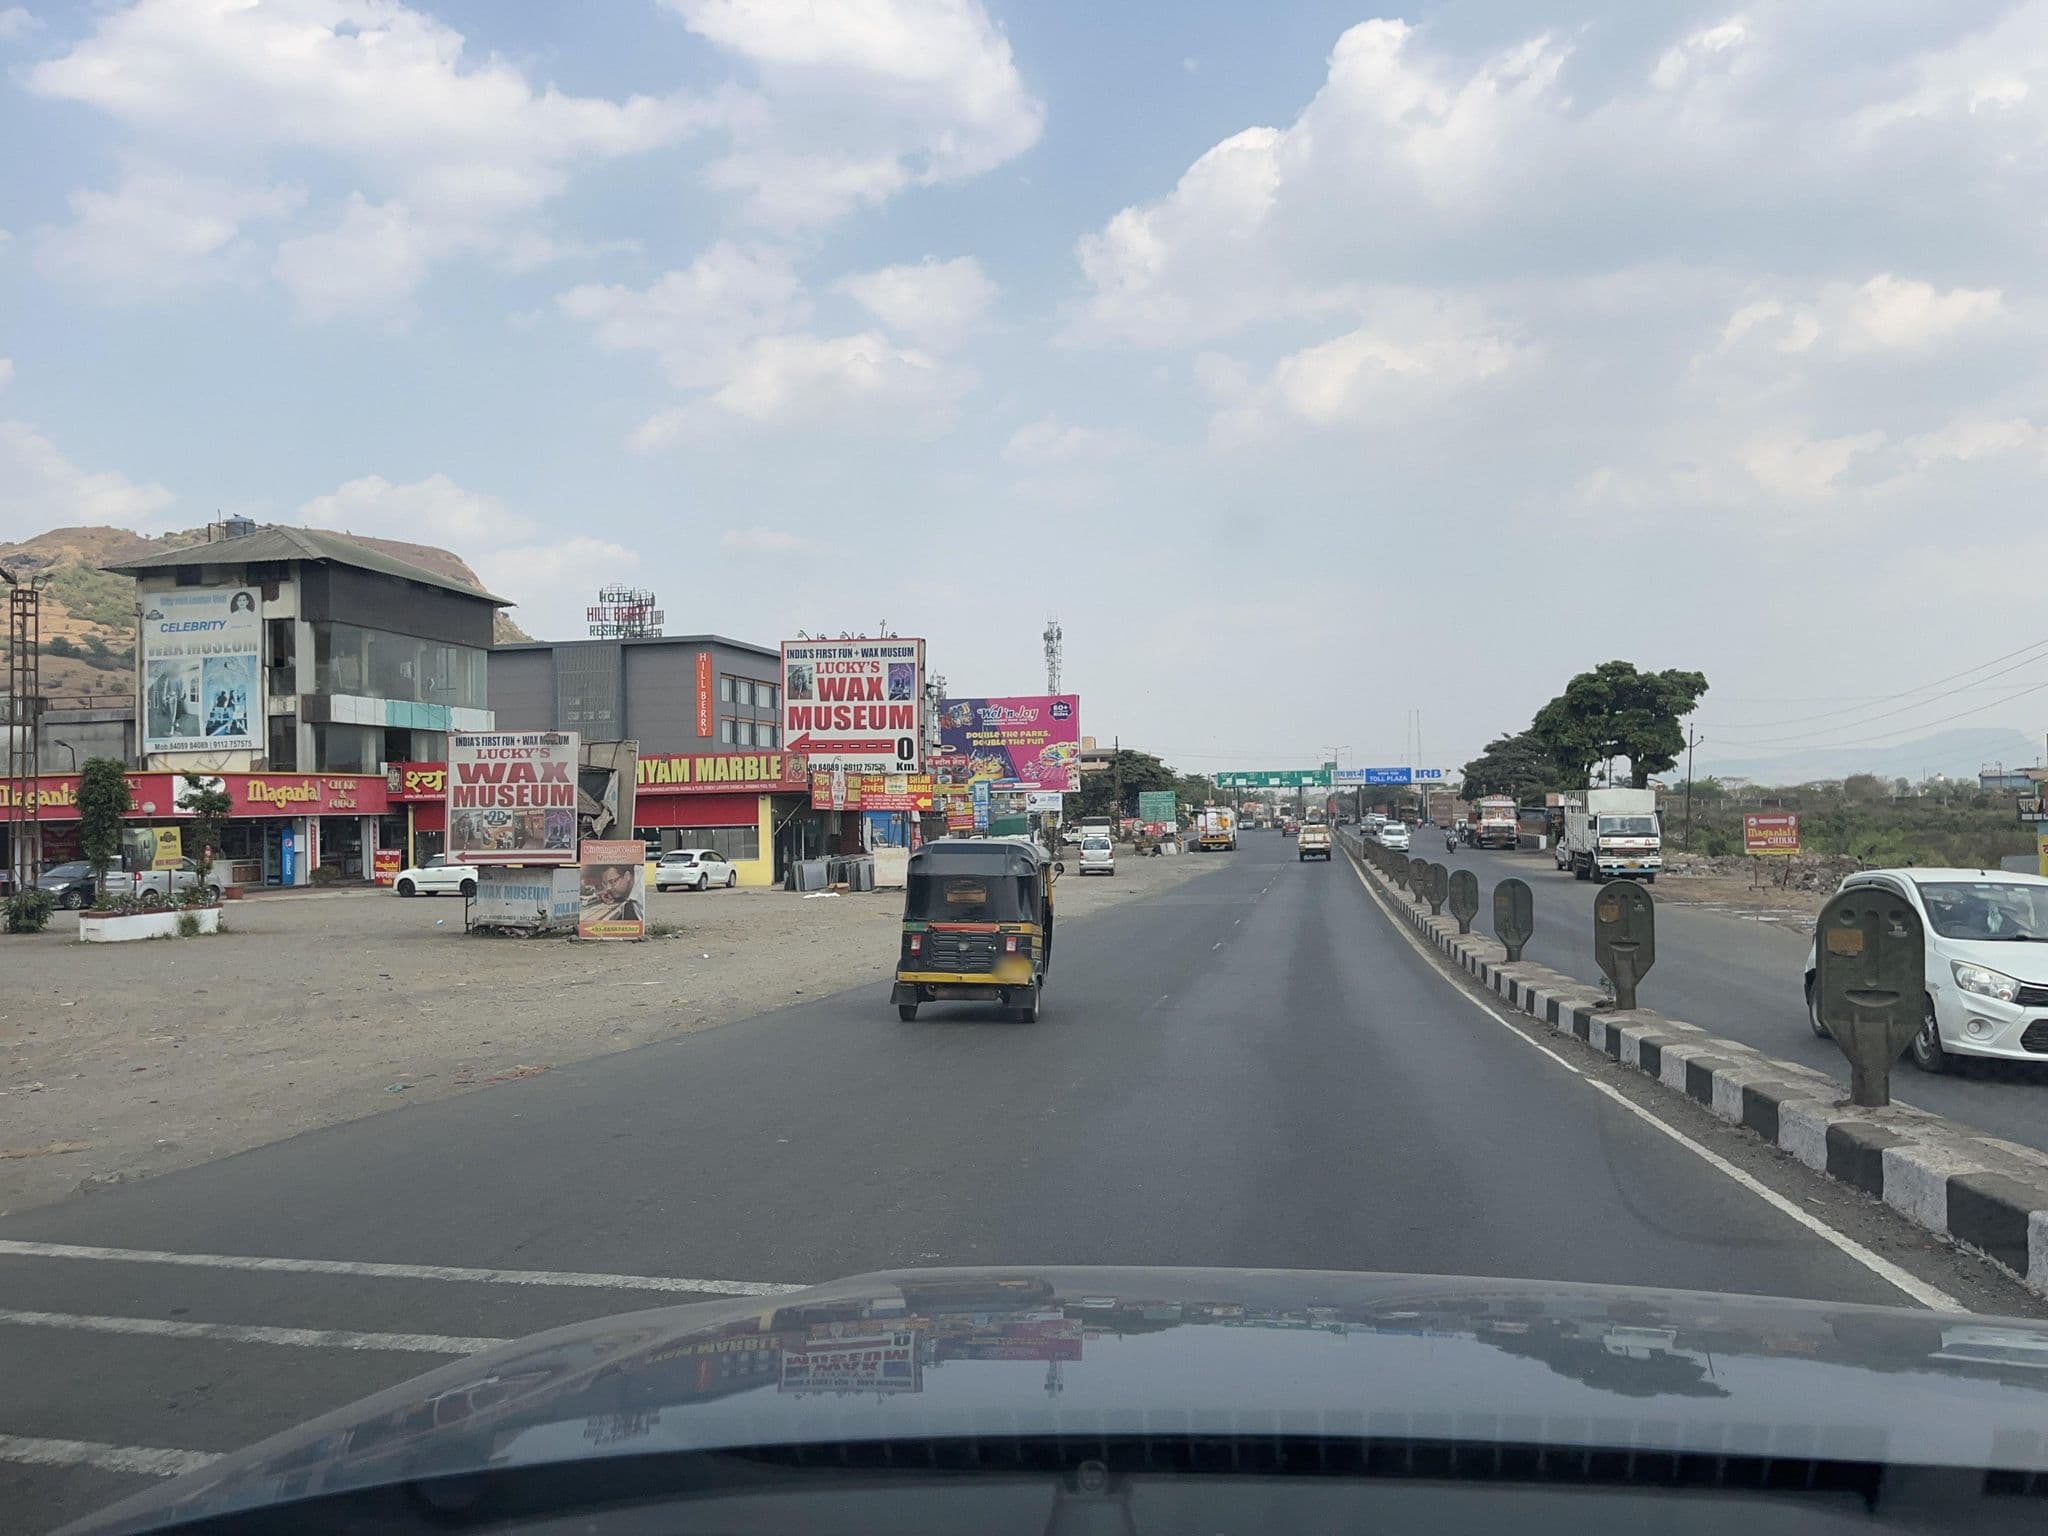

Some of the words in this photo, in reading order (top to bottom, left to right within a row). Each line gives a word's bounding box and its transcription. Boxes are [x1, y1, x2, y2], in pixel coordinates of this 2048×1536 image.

[599, 589, 633, 603] HOTEL
[587, 607, 610, 622] HILL
[160, 620, 227, 633] CELEBRITY
[786, 649, 815, 659] INDIA'S
[815, 648, 836, 659] FIRST
[838, 647, 853, 658] FUN
[861, 647, 880, 658] WAX
[880, 646, 914, 658] MUSEUM
[699, 652, 708, 689] HILL
[815, 661, 880, 674] LUCKY'S
[817, 676, 885, 702] WAX
[700, 691, 708, 737] BERRY
[787, 704, 914, 731] MUSEUM
[455, 736, 481, 747] INDIA'S
[482, 736, 501, 746] FIRST
[502, 735, 515, 746] FUN
[522, 735, 539, 745] WAX
[476, 748, 550, 759] LUCKY'S
[457, 762, 570, 784] WAX
[636, 758, 690, 784] HYAM
[695, 755, 782, 782] MARBLE
[1415, 769, 1441, 778] IRB
[453, 784, 574, 807] MUSEUM
[504, 886, 550, 900] MUSEUM
